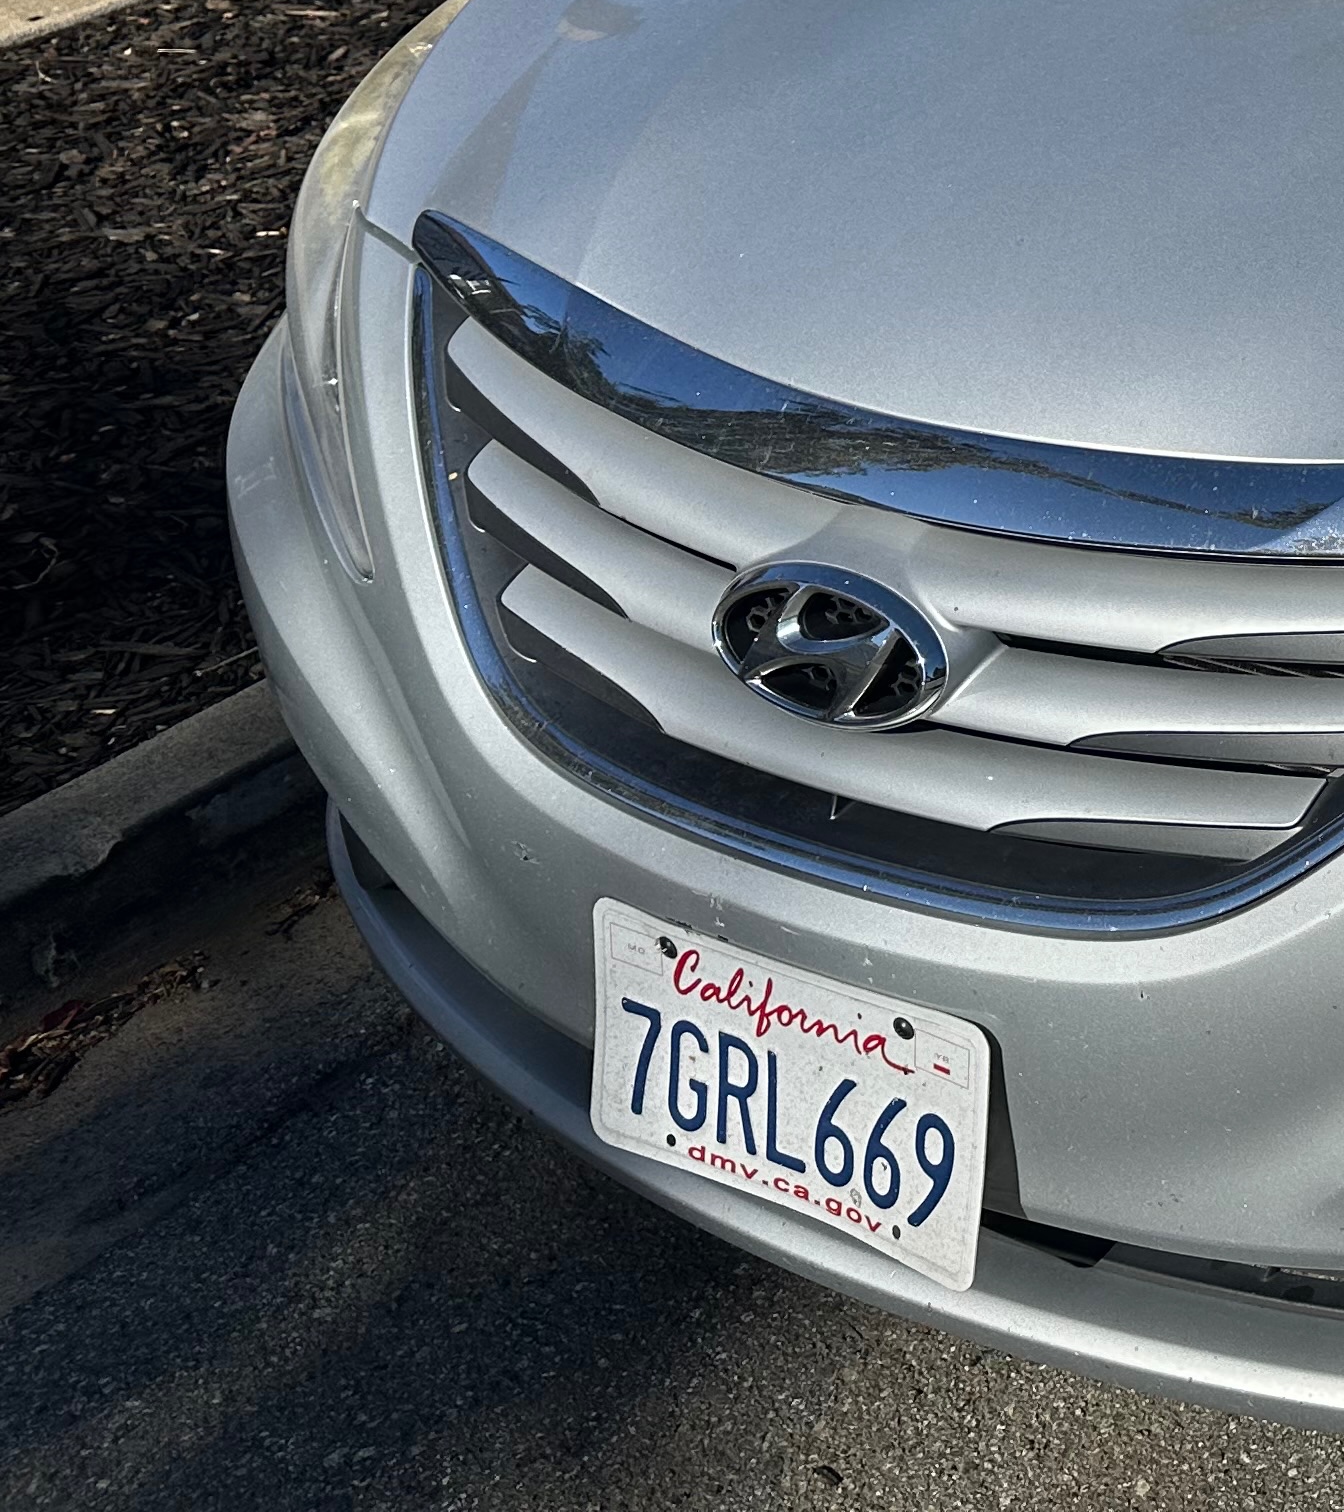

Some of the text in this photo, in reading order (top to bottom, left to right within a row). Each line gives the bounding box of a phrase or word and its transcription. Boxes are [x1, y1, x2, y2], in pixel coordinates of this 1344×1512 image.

[673, 949, 915, 1075] California
[621, 997, 956, 1227] 7GRL669
[687, 1145, 883, 1234] dmv.ca.gov
